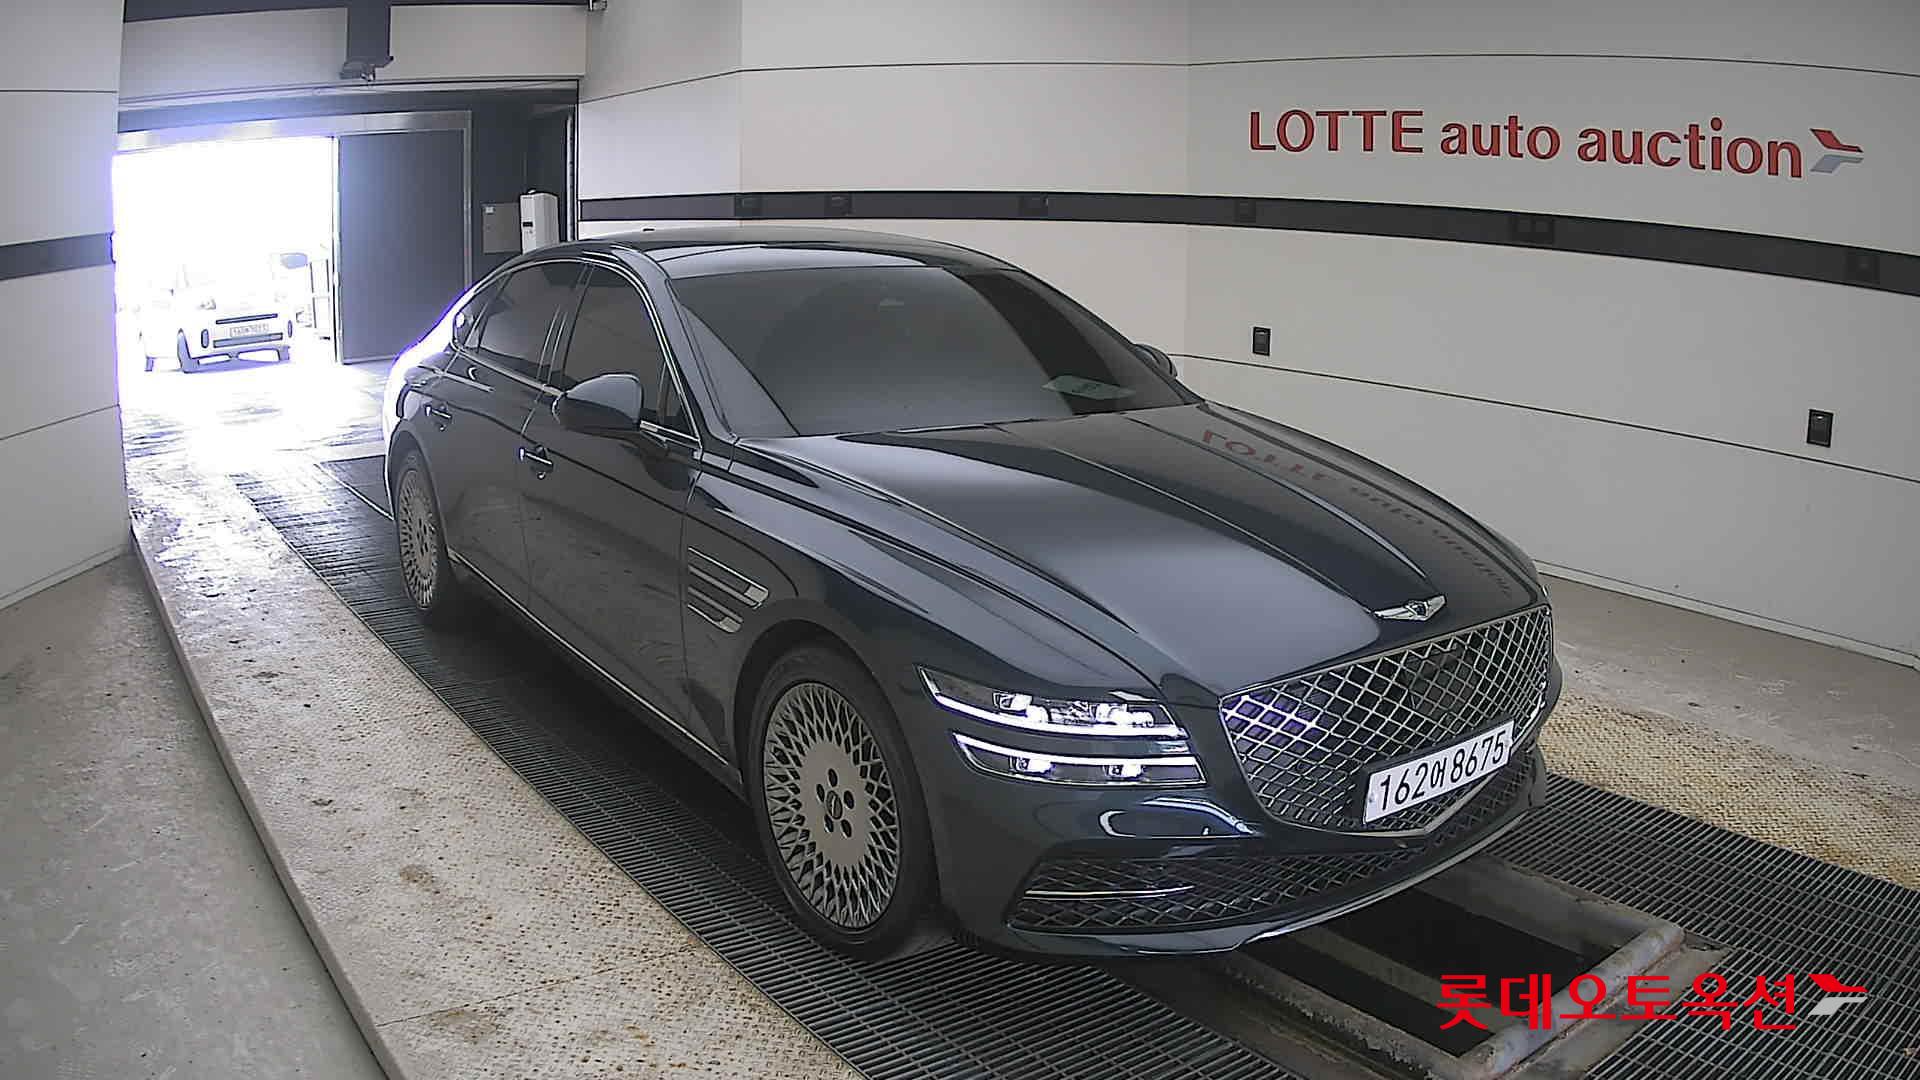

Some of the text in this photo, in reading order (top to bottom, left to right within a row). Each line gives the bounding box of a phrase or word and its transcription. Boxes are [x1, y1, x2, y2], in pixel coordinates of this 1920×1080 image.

[1249, 110, 1803, 178] LOTTE auto auction
